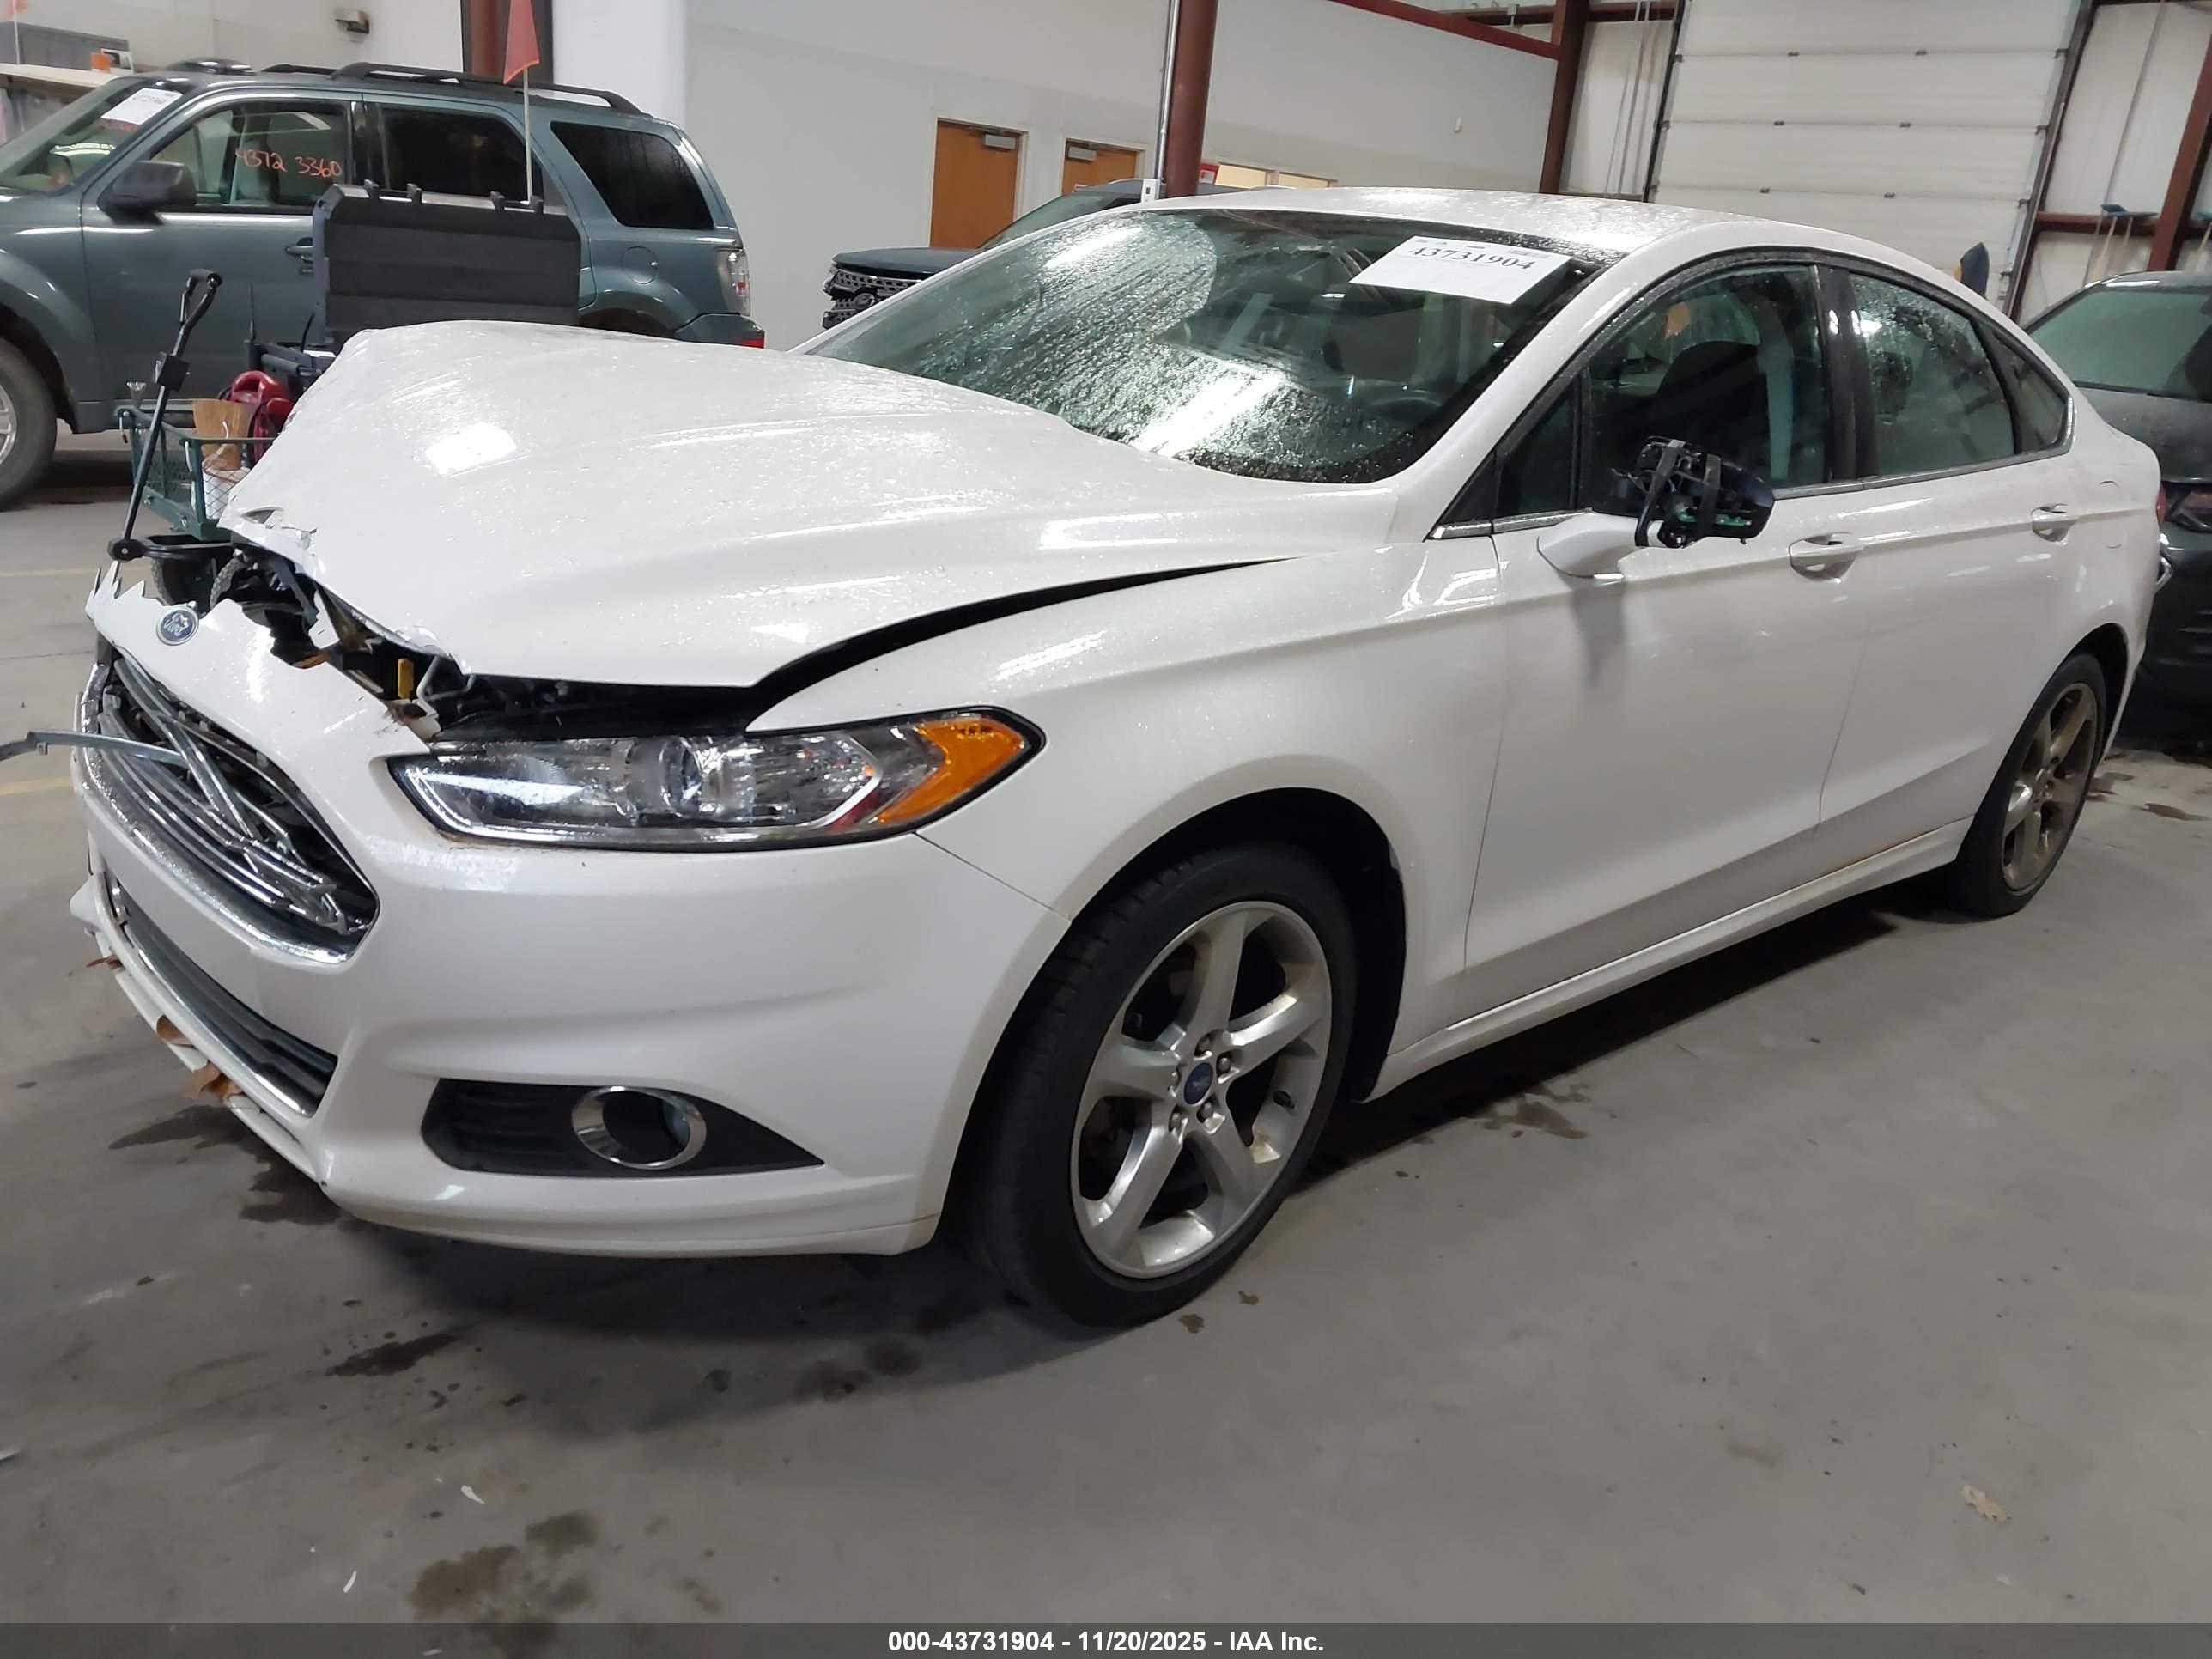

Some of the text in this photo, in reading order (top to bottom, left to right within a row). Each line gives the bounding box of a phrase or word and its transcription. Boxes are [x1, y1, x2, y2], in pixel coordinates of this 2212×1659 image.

[235, 148, 343, 179] 4372 3360
[1408, 246, 1536, 270] 43731904
